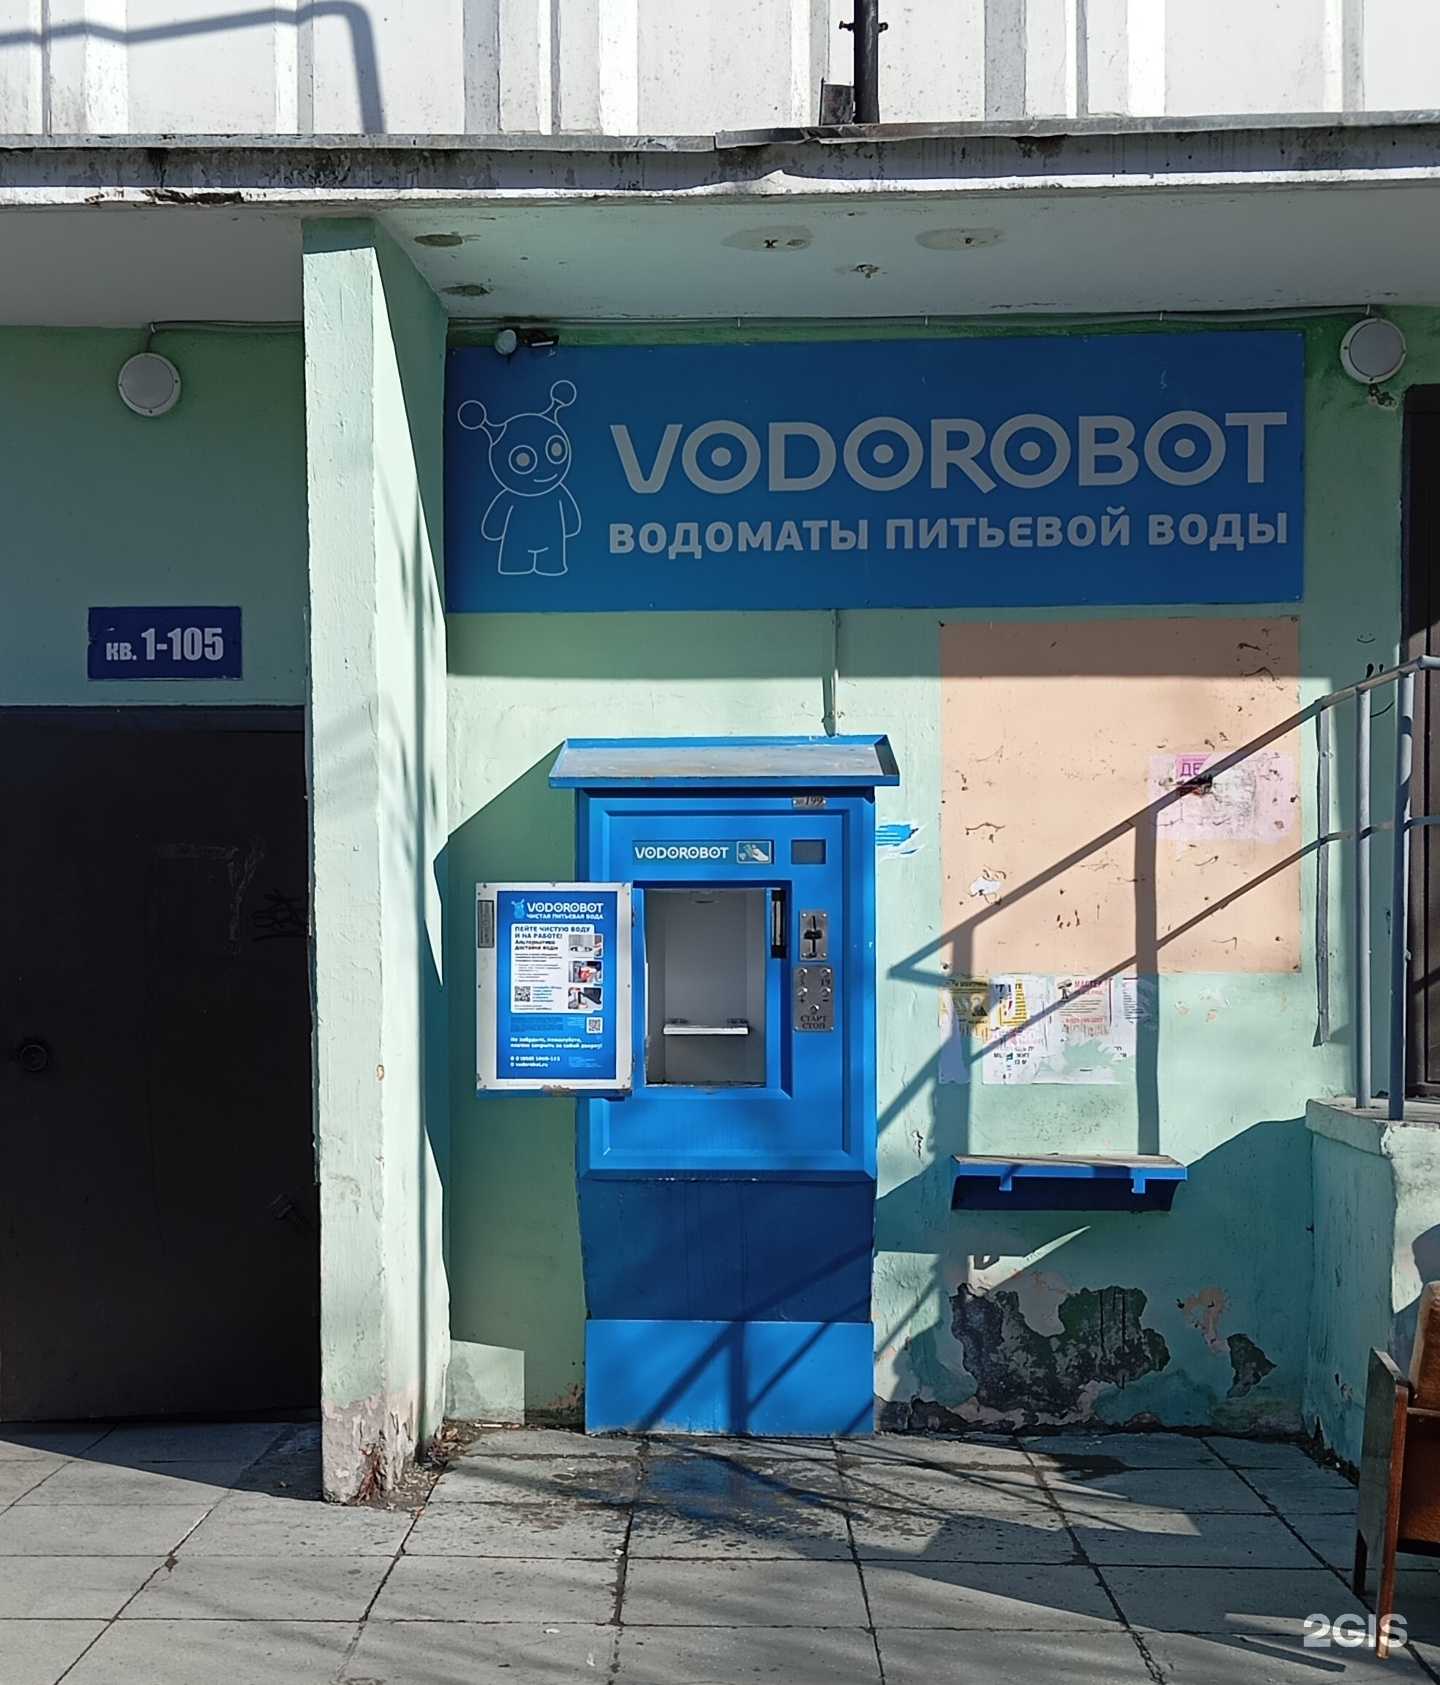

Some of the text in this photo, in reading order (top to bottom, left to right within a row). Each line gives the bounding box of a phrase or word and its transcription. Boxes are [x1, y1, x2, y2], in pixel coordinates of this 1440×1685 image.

[609, 410, 1288, 494] VODOROBOT
[609, 505, 1287, 560] ВОДОМАТЫ ПИТЬЕВОЙ ВОДЫ
[141, 626, 225, 661] 1-105
[634, 846, 729, 859] VODOROBOT
[526, 902, 604, 913] VODOROBOT
